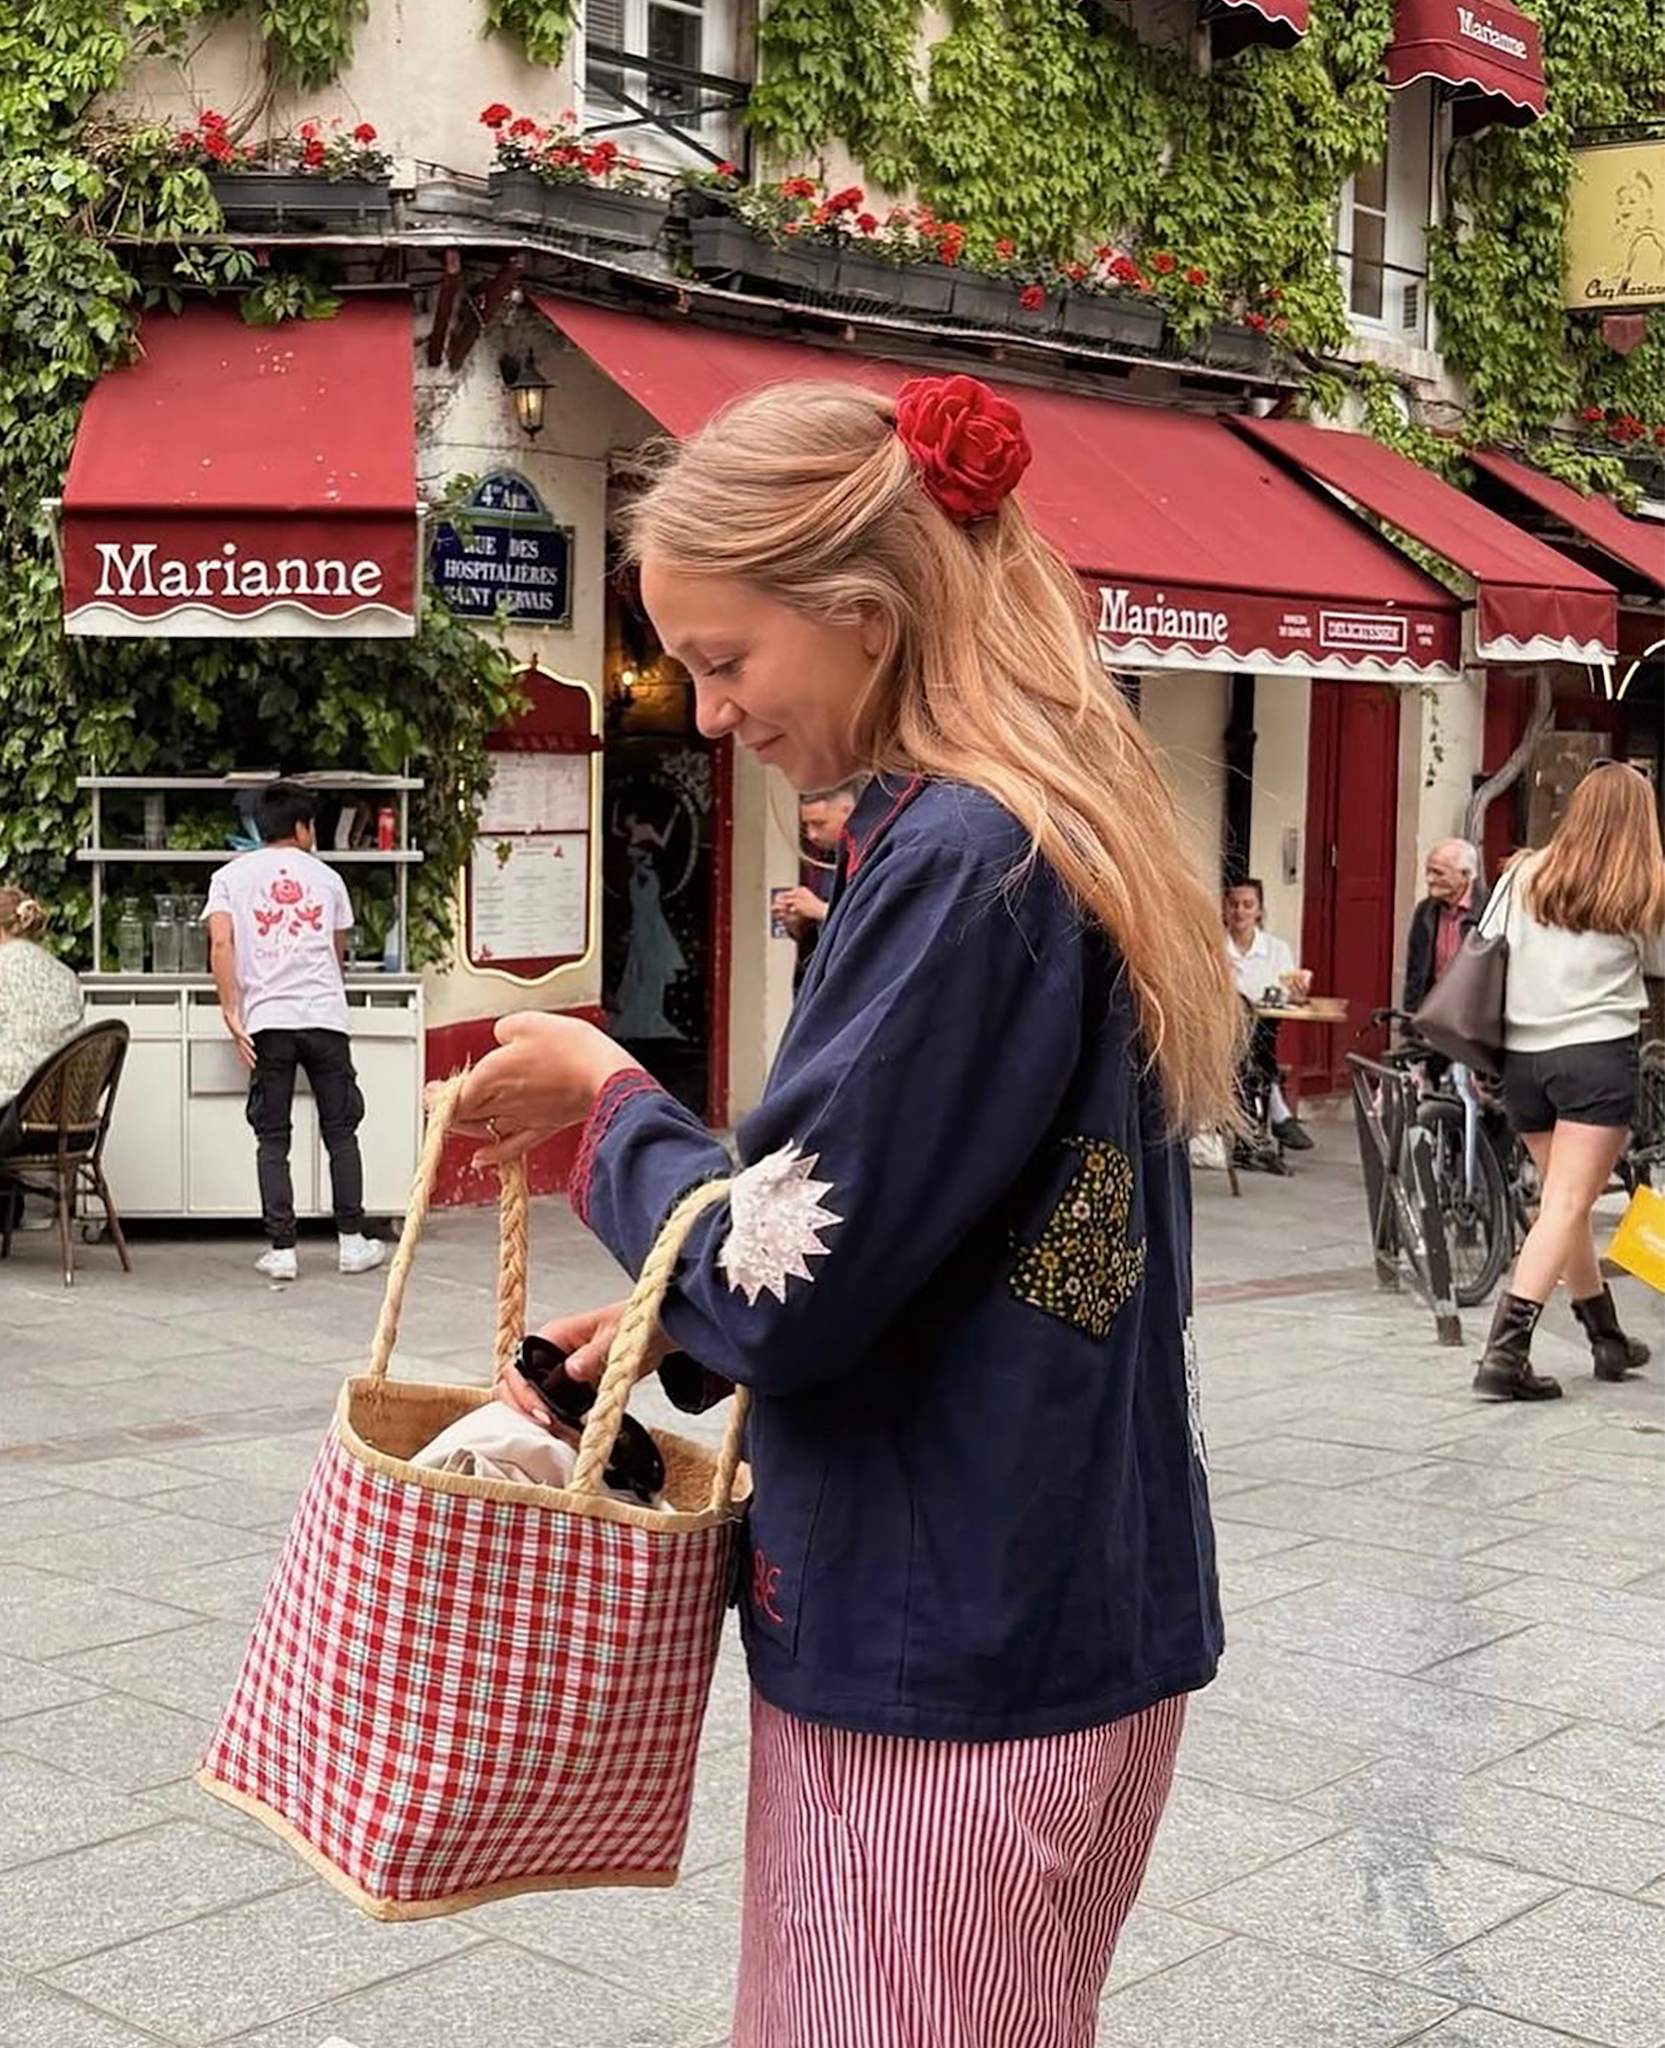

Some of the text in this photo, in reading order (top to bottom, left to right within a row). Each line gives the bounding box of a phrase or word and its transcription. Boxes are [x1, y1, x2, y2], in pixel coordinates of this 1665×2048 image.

[1457, 7, 1527, 59] Marianne
[94, 543, 384, 597] Marianne
[444, 558, 558, 586] HOSPITALIÈRES
[509, 538, 540, 560] DES
[1098, 586, 1229, 643] Marianne
